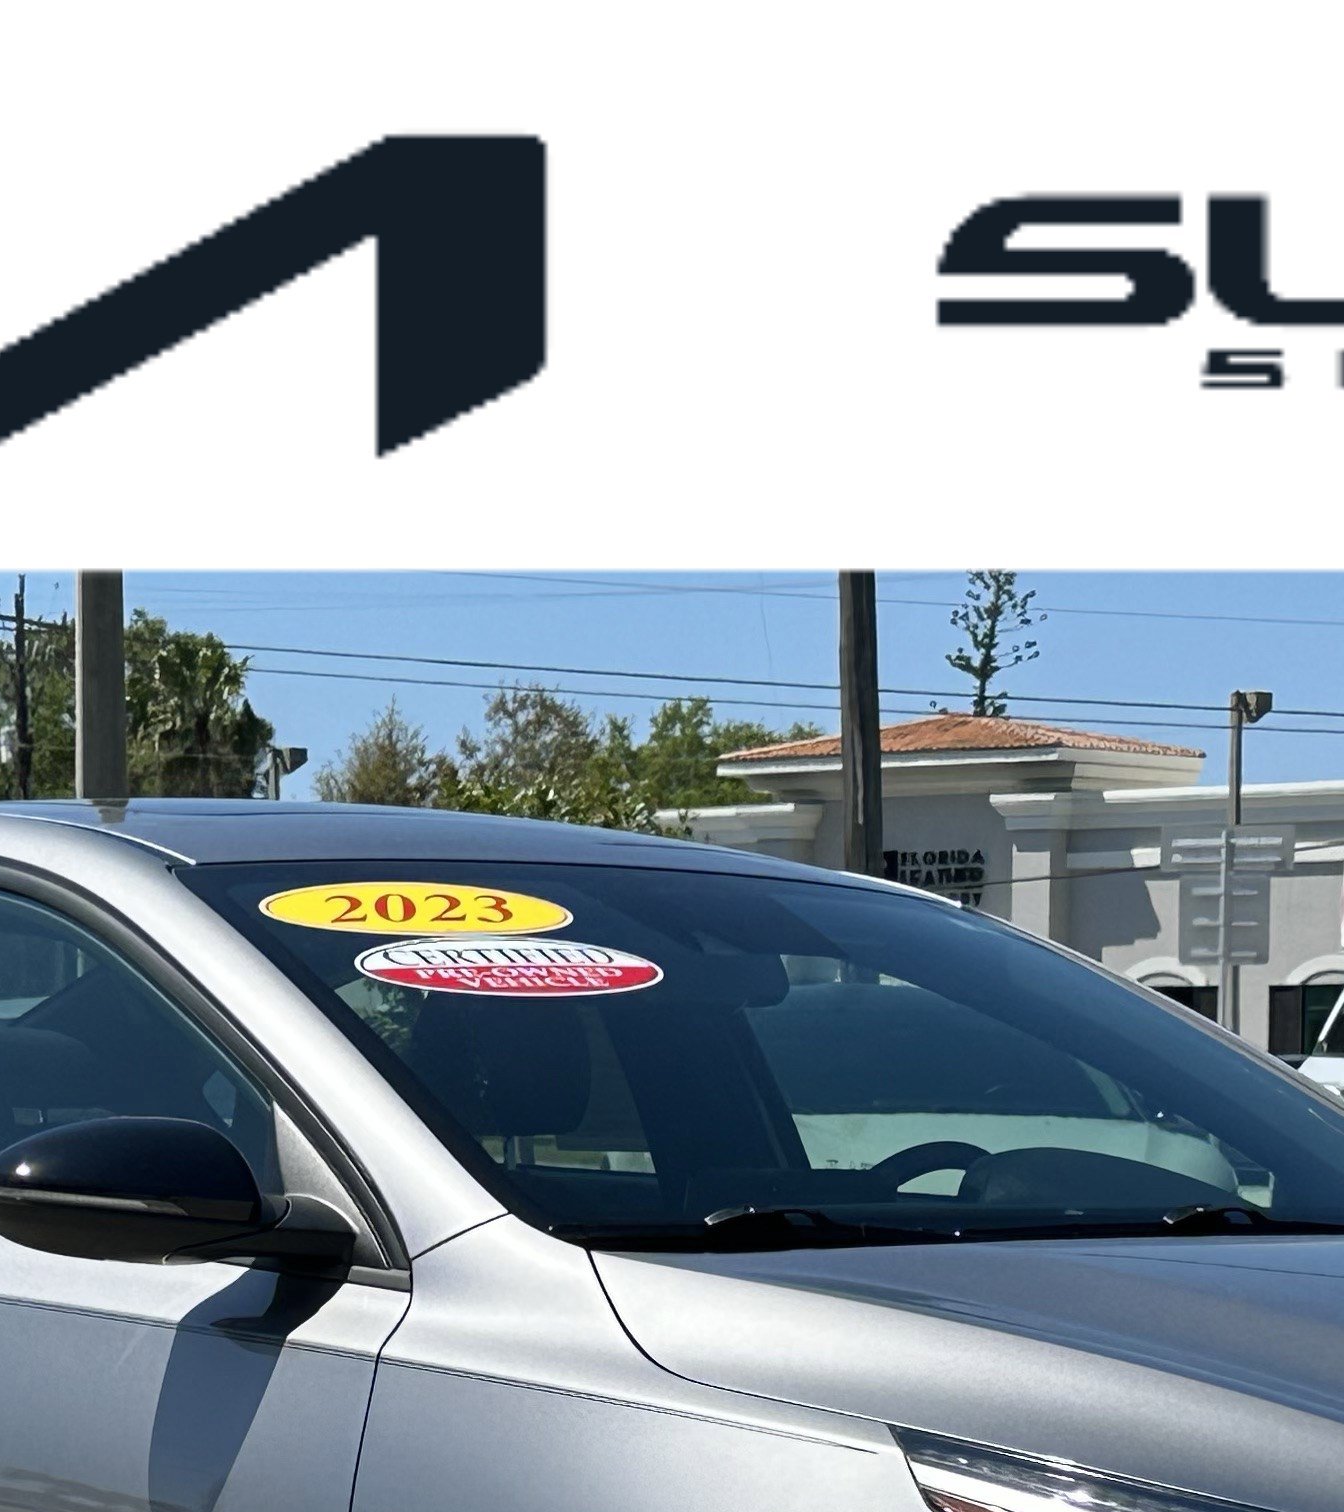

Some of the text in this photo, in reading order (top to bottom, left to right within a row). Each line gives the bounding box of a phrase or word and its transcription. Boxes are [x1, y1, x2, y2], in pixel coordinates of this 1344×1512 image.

[325, 894, 514, 924] 2023
[382, 948, 616, 966] CERTIFIED
[415, 966, 623, 980] PRE-OWNED
[457, 976, 610, 989] VEHICLE
